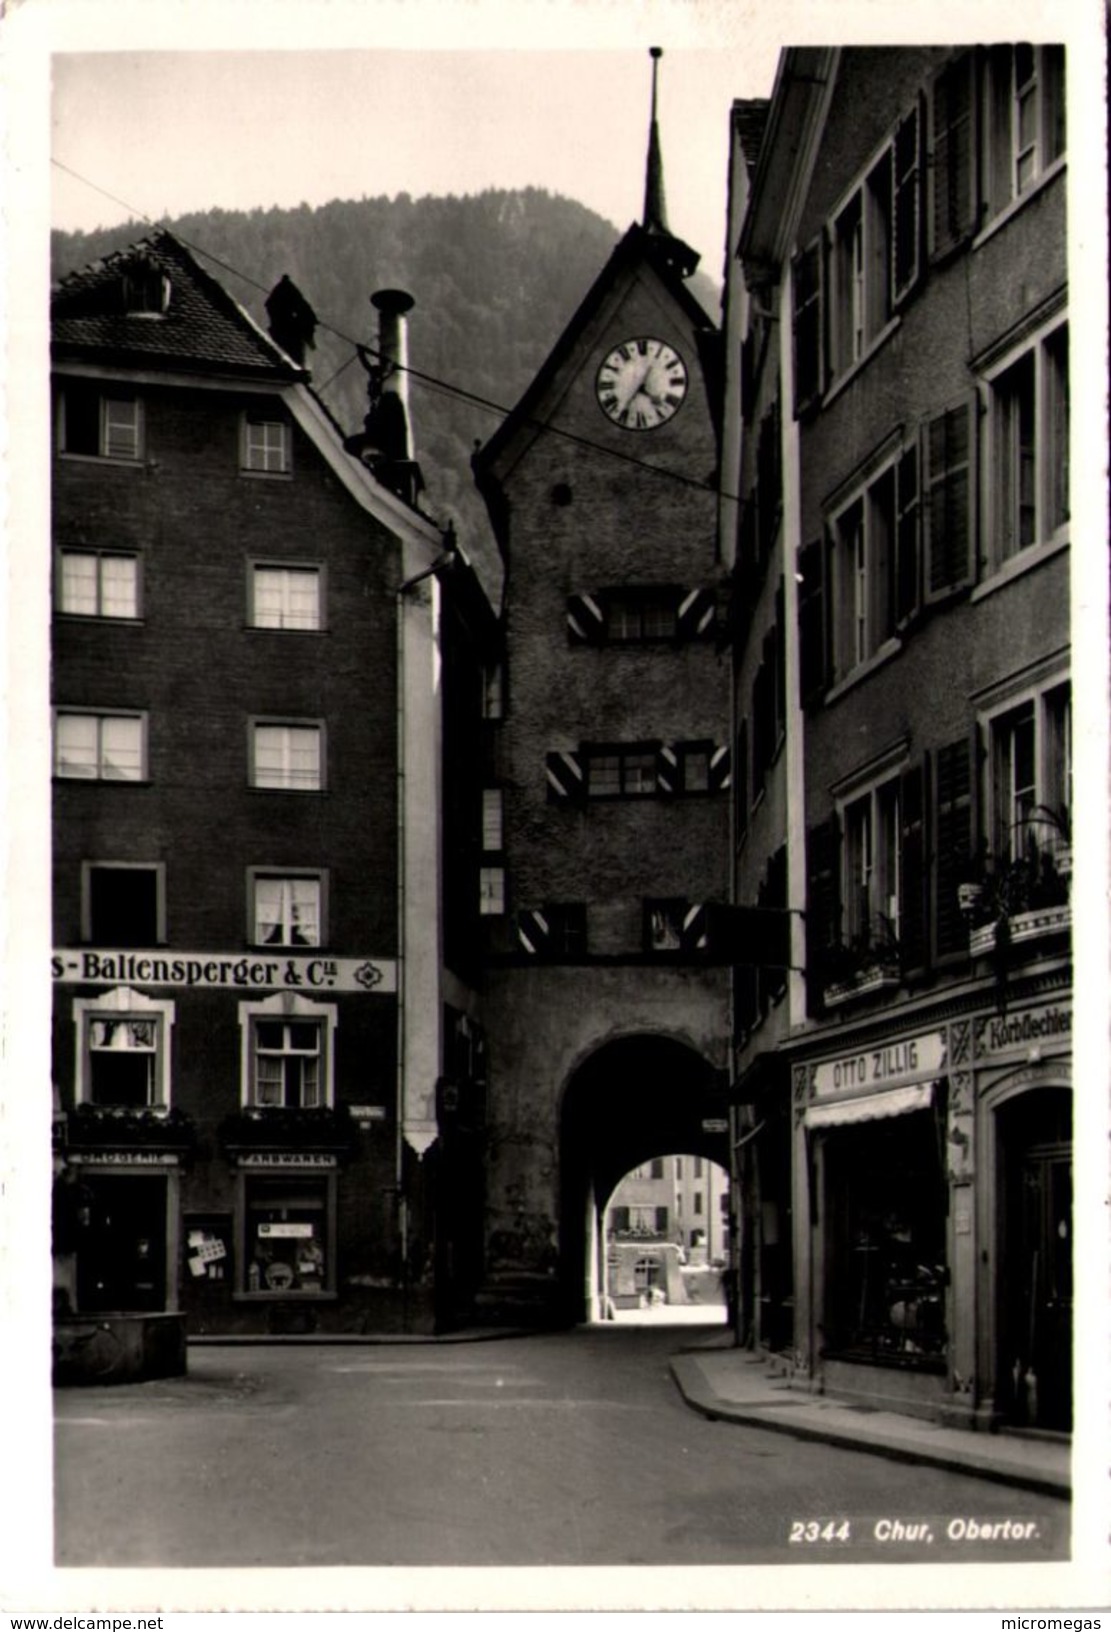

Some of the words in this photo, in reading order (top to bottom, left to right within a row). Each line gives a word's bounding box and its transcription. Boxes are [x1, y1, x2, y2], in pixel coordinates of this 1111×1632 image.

[284, 960, 302, 985] &
[833, 1056, 866, 1089] OTTO
[873, 1042, 918, 1079] ZILLIG
[243, 1153, 333, 1166] FARBWAREN
